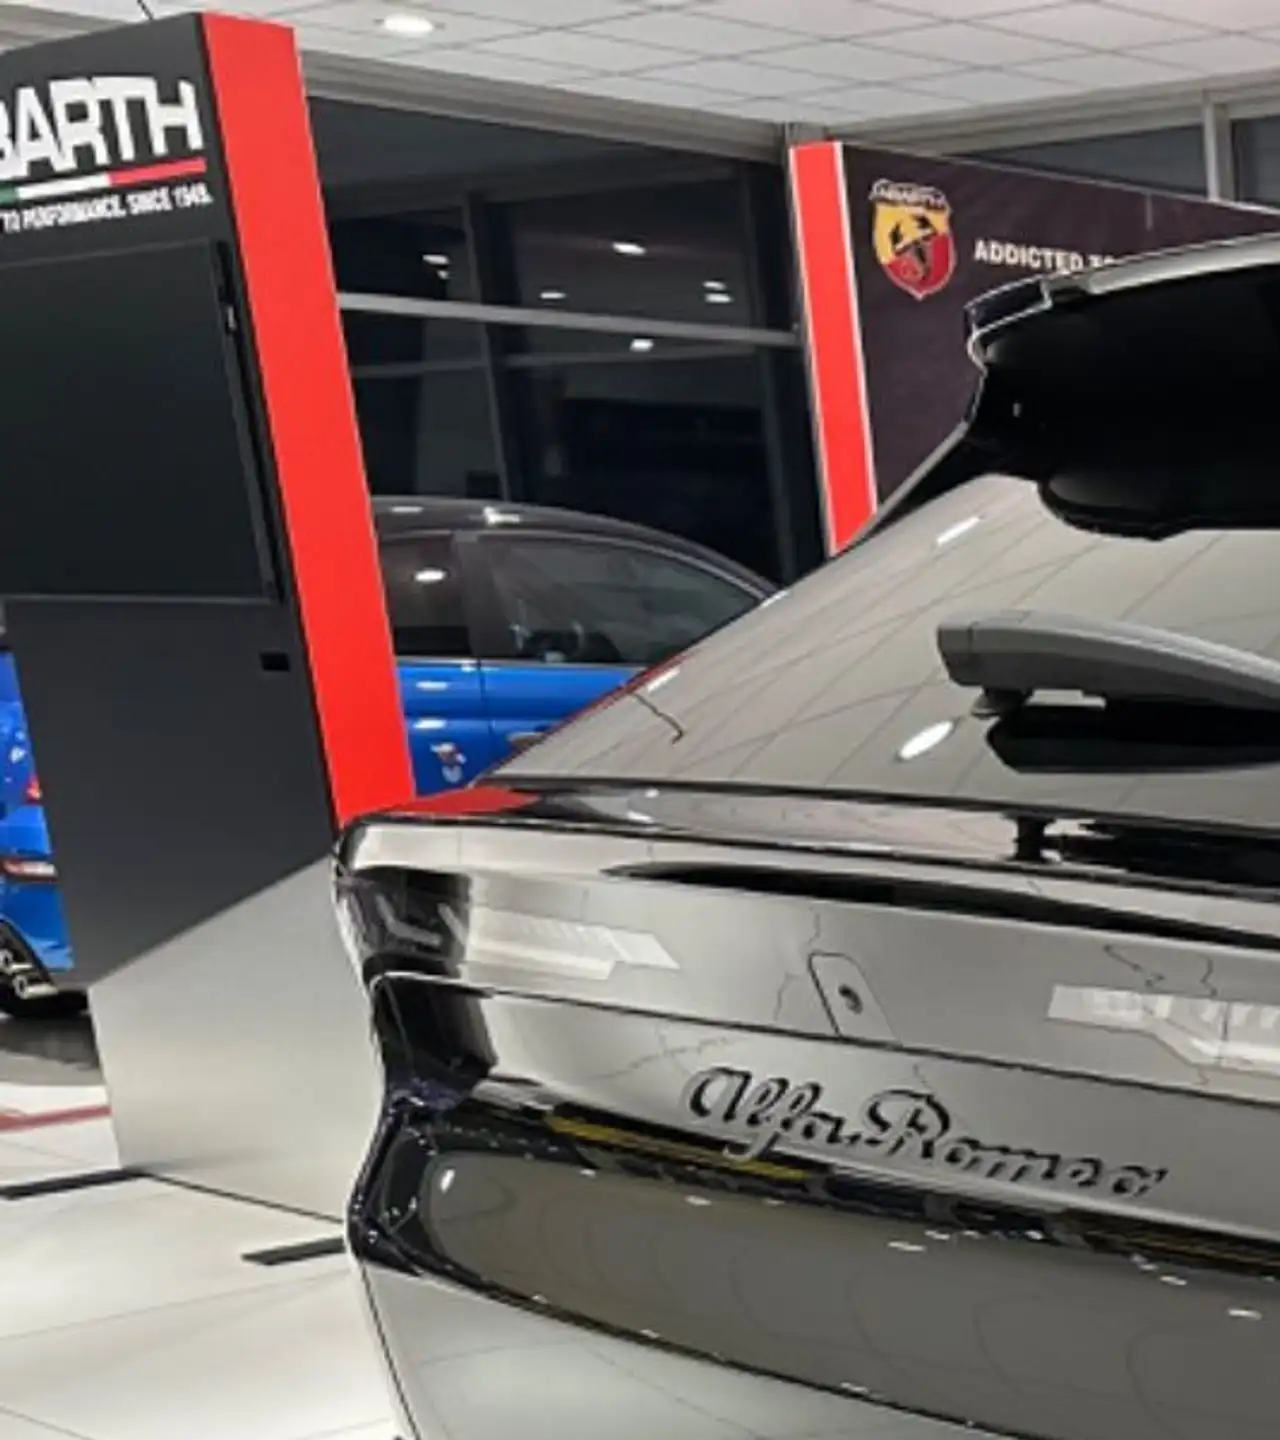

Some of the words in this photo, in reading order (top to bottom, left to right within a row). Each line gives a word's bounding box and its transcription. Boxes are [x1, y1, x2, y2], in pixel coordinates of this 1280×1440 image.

[974, 238, 1085, 275] ADDICTED
[682, 1066, 862, 1161] Alfa
[860, 1088, 1169, 1199] Romeo
